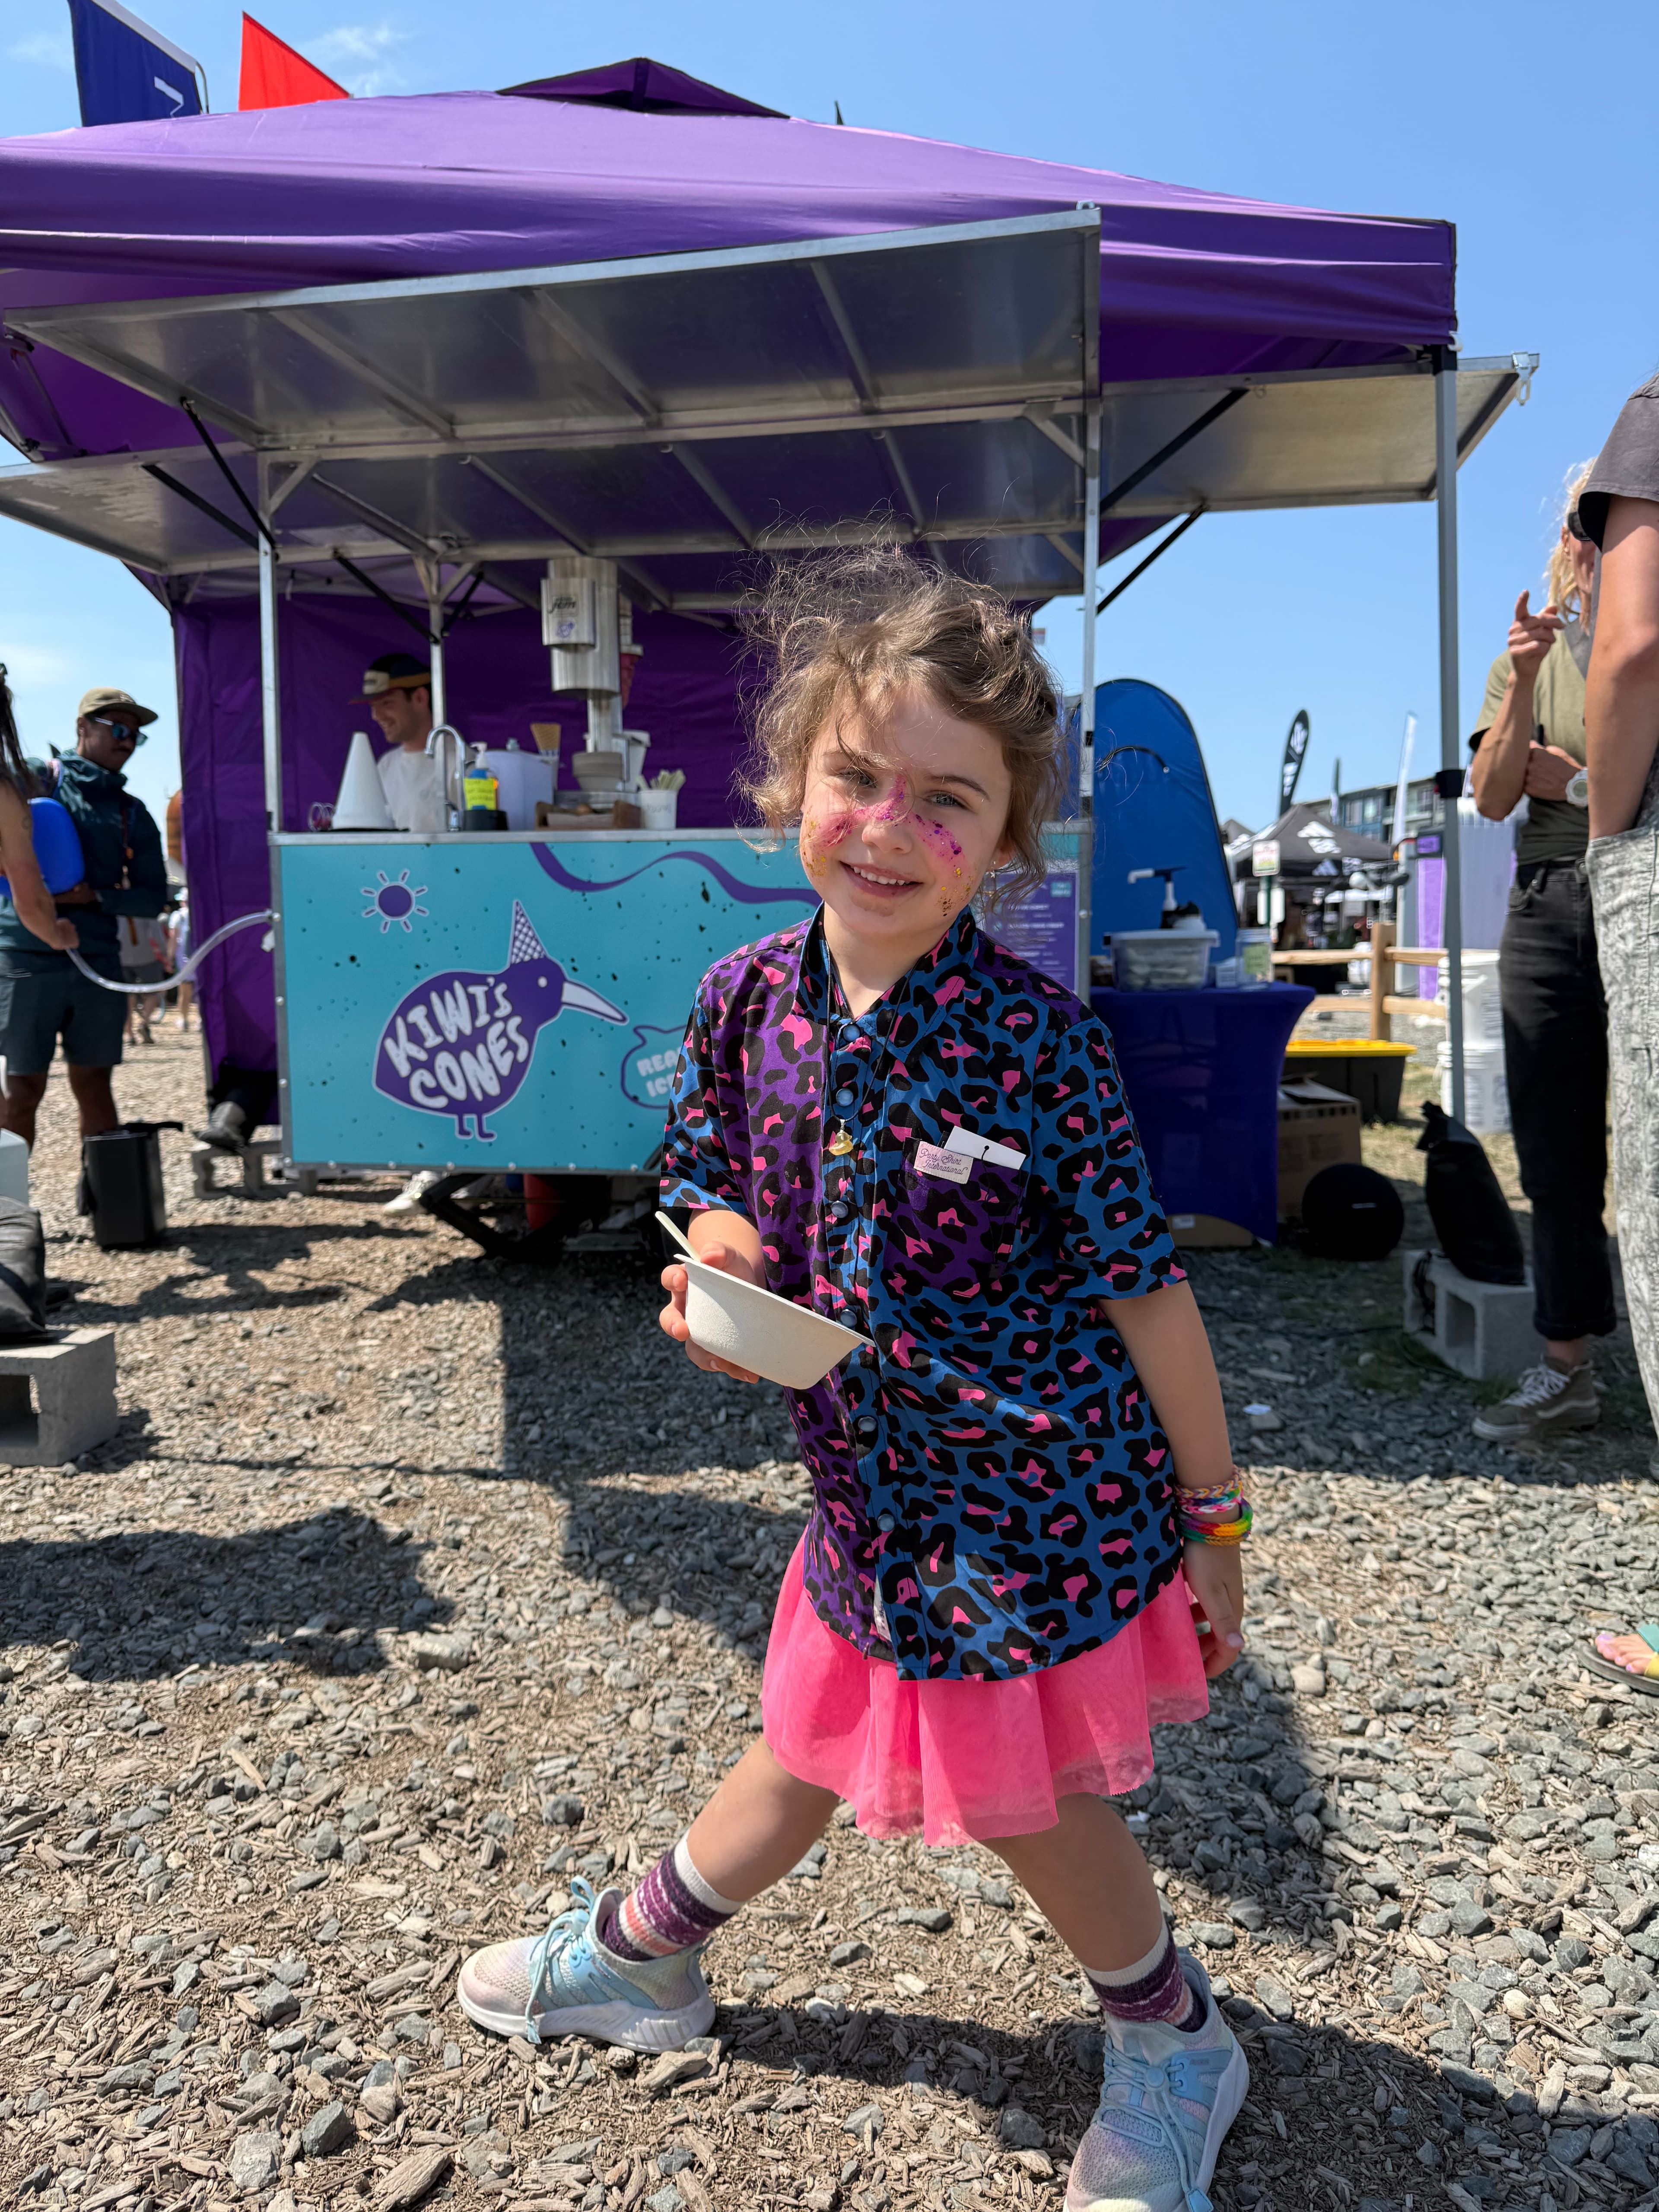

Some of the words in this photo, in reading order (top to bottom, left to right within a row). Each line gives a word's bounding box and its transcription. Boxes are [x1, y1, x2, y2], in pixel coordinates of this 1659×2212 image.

[383, 976, 512, 1077] KIWI'S
[409, 1015, 529, 1109] CONES
[637, 1047, 681, 1077] REA
[919, 1148, 940, 1162] Party
[941, 1154, 962, 1165] Shirt
[922, 1159, 968, 1175] International
